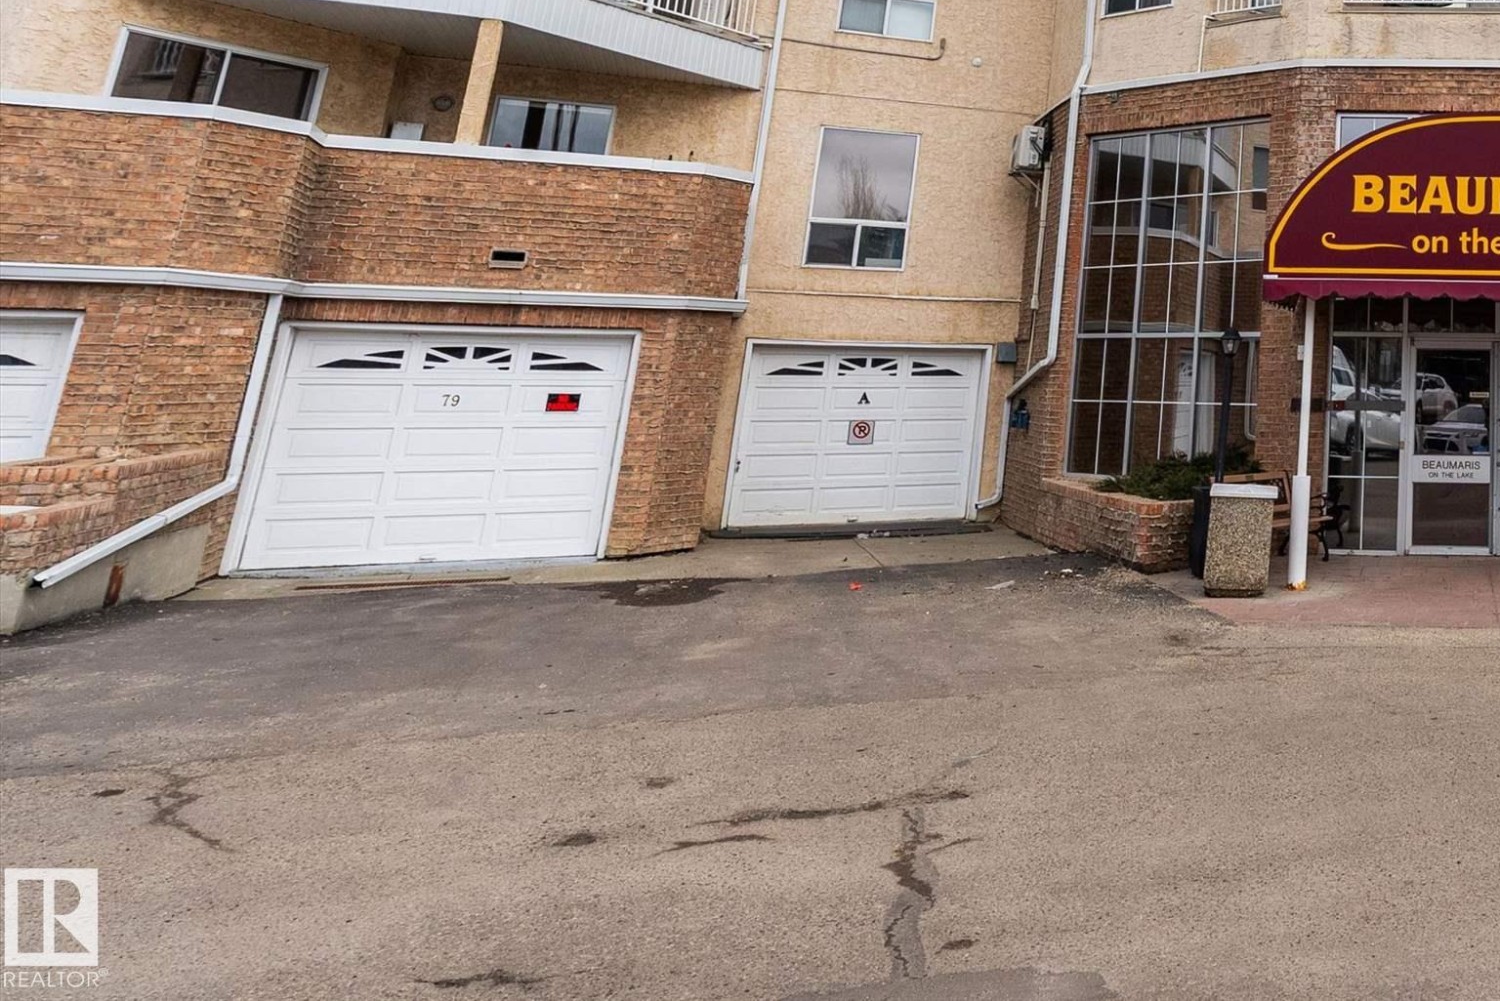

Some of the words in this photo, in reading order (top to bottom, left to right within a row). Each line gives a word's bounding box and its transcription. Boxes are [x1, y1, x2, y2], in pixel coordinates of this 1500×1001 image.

[1412, 234, 1449, 254] on
[442, 394, 461, 407] 79
[857, 391, 871, 405] A
[1422, 460, 1481, 470] BEAUMARIS
[1428, 471, 1439, 479] ON
[1442, 471, 1455, 479] THE
[1457, 471, 1474, 479] LAKE
